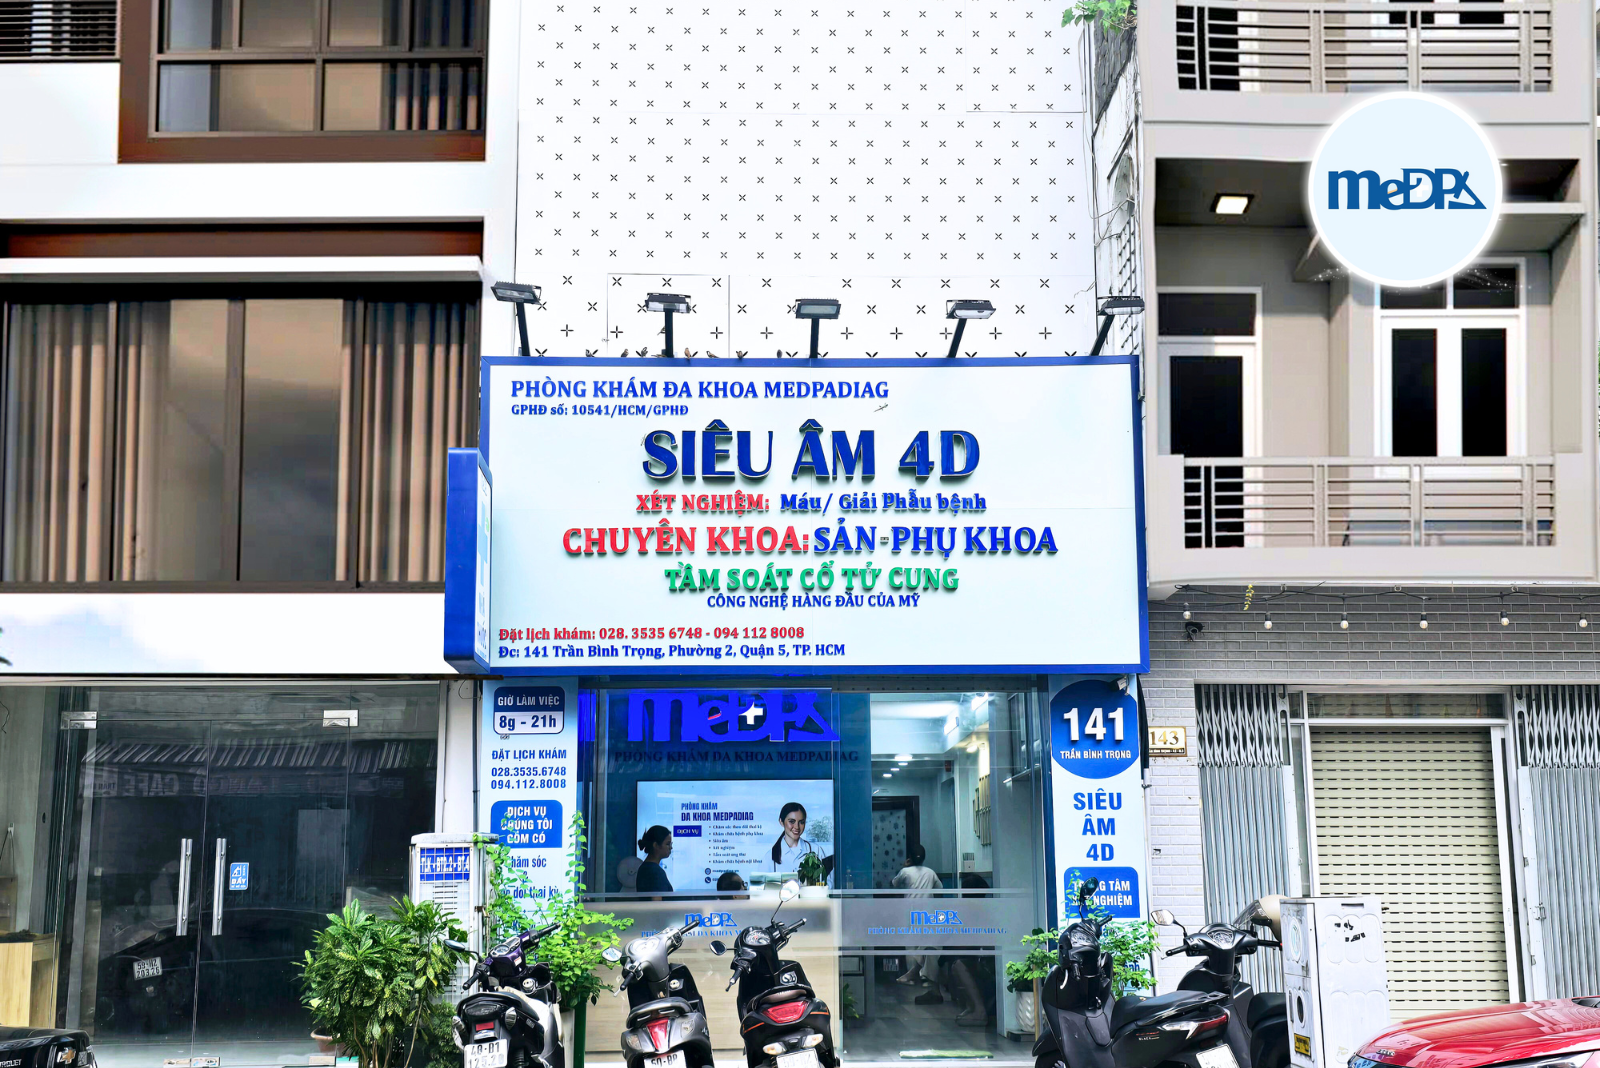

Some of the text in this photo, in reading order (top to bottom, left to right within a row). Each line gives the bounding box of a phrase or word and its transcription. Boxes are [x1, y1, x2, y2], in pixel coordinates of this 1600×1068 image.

[511, 376, 889, 398] PHÒNG KHÁM ĐA KHOA MEDPADIAG
[511, 404, 689, 418] GPHĐ số: 10541/HCM/GPHĐ
[642, 419, 980, 481] SIÊU ÂM 4D
[636, 489, 987, 517] XÉT NGHIỆM: Máu/ Giải Phẫu bệnh
[562, 517, 697, 556] CHUYÊN
[706, 525, 810, 555] KHOA:
[963, 526, 1059, 555] KHOA
[664, 560, 960, 592] TẦM SOÁT CỔ TỬ CUNG
[707, 592, 920, 611] CÔNG NGHỆ HÀNG ĐẦU CỦA MỸ
[499, 628, 523, 643] Đặt
[526, 628, 551, 643] lịch
[554, 627, 596, 640] khám:
[599, 627, 628, 640] 028.
[631, 627, 665, 639] 3535
[668, 627, 703, 639] 6748
[713, 627, 739, 639] 094
[742, 627, 767, 639] 112
[770, 627, 805, 639] 8008
[499, 644, 846, 660] Đc: 141 Trần Bình Trọng, Phường 2, Quận 5, TP. HCM
[497, 694, 560, 707] GIỜ LÀM VIỆC
[499, 715, 515, 731] 8g
[531, 715, 557, 728] 21h
[1063, 707, 1124, 741] 141
[1150, 731, 1179, 745] 143
[492, 747, 567, 761] ĐẶT LỊCH KHÁM
[615, 748, 663, 762] PHÒNG
[667, 748, 709, 762] KHÁM
[734, 751, 774, 762] KHOA
[1060, 748, 1131, 761] TRẦN BÌNH TRỌNG
[491, 767, 567, 777] 028.3535.6748
[490, 779, 567, 789] 094.112.8008
[681, 801, 718, 810] PHÒNG KHÁM
[1073, 788, 1122, 810] SIÊU
[507, 806, 546, 818] DỊCH VỤ
[693, 812, 711, 821] KHOA
[713, 812, 754, 821] MEDPADIAG
[537, 818, 552, 829] TÔI
[1082, 814, 1116, 836] ÂM
[532, 831, 546, 843] CÓ
[1086, 843, 1114, 861] 4D
[509, 855, 546, 868] hăm sóc
[1109, 878, 1130, 891] TÂM
[1093, 893, 1132, 908] NGHIỆM
